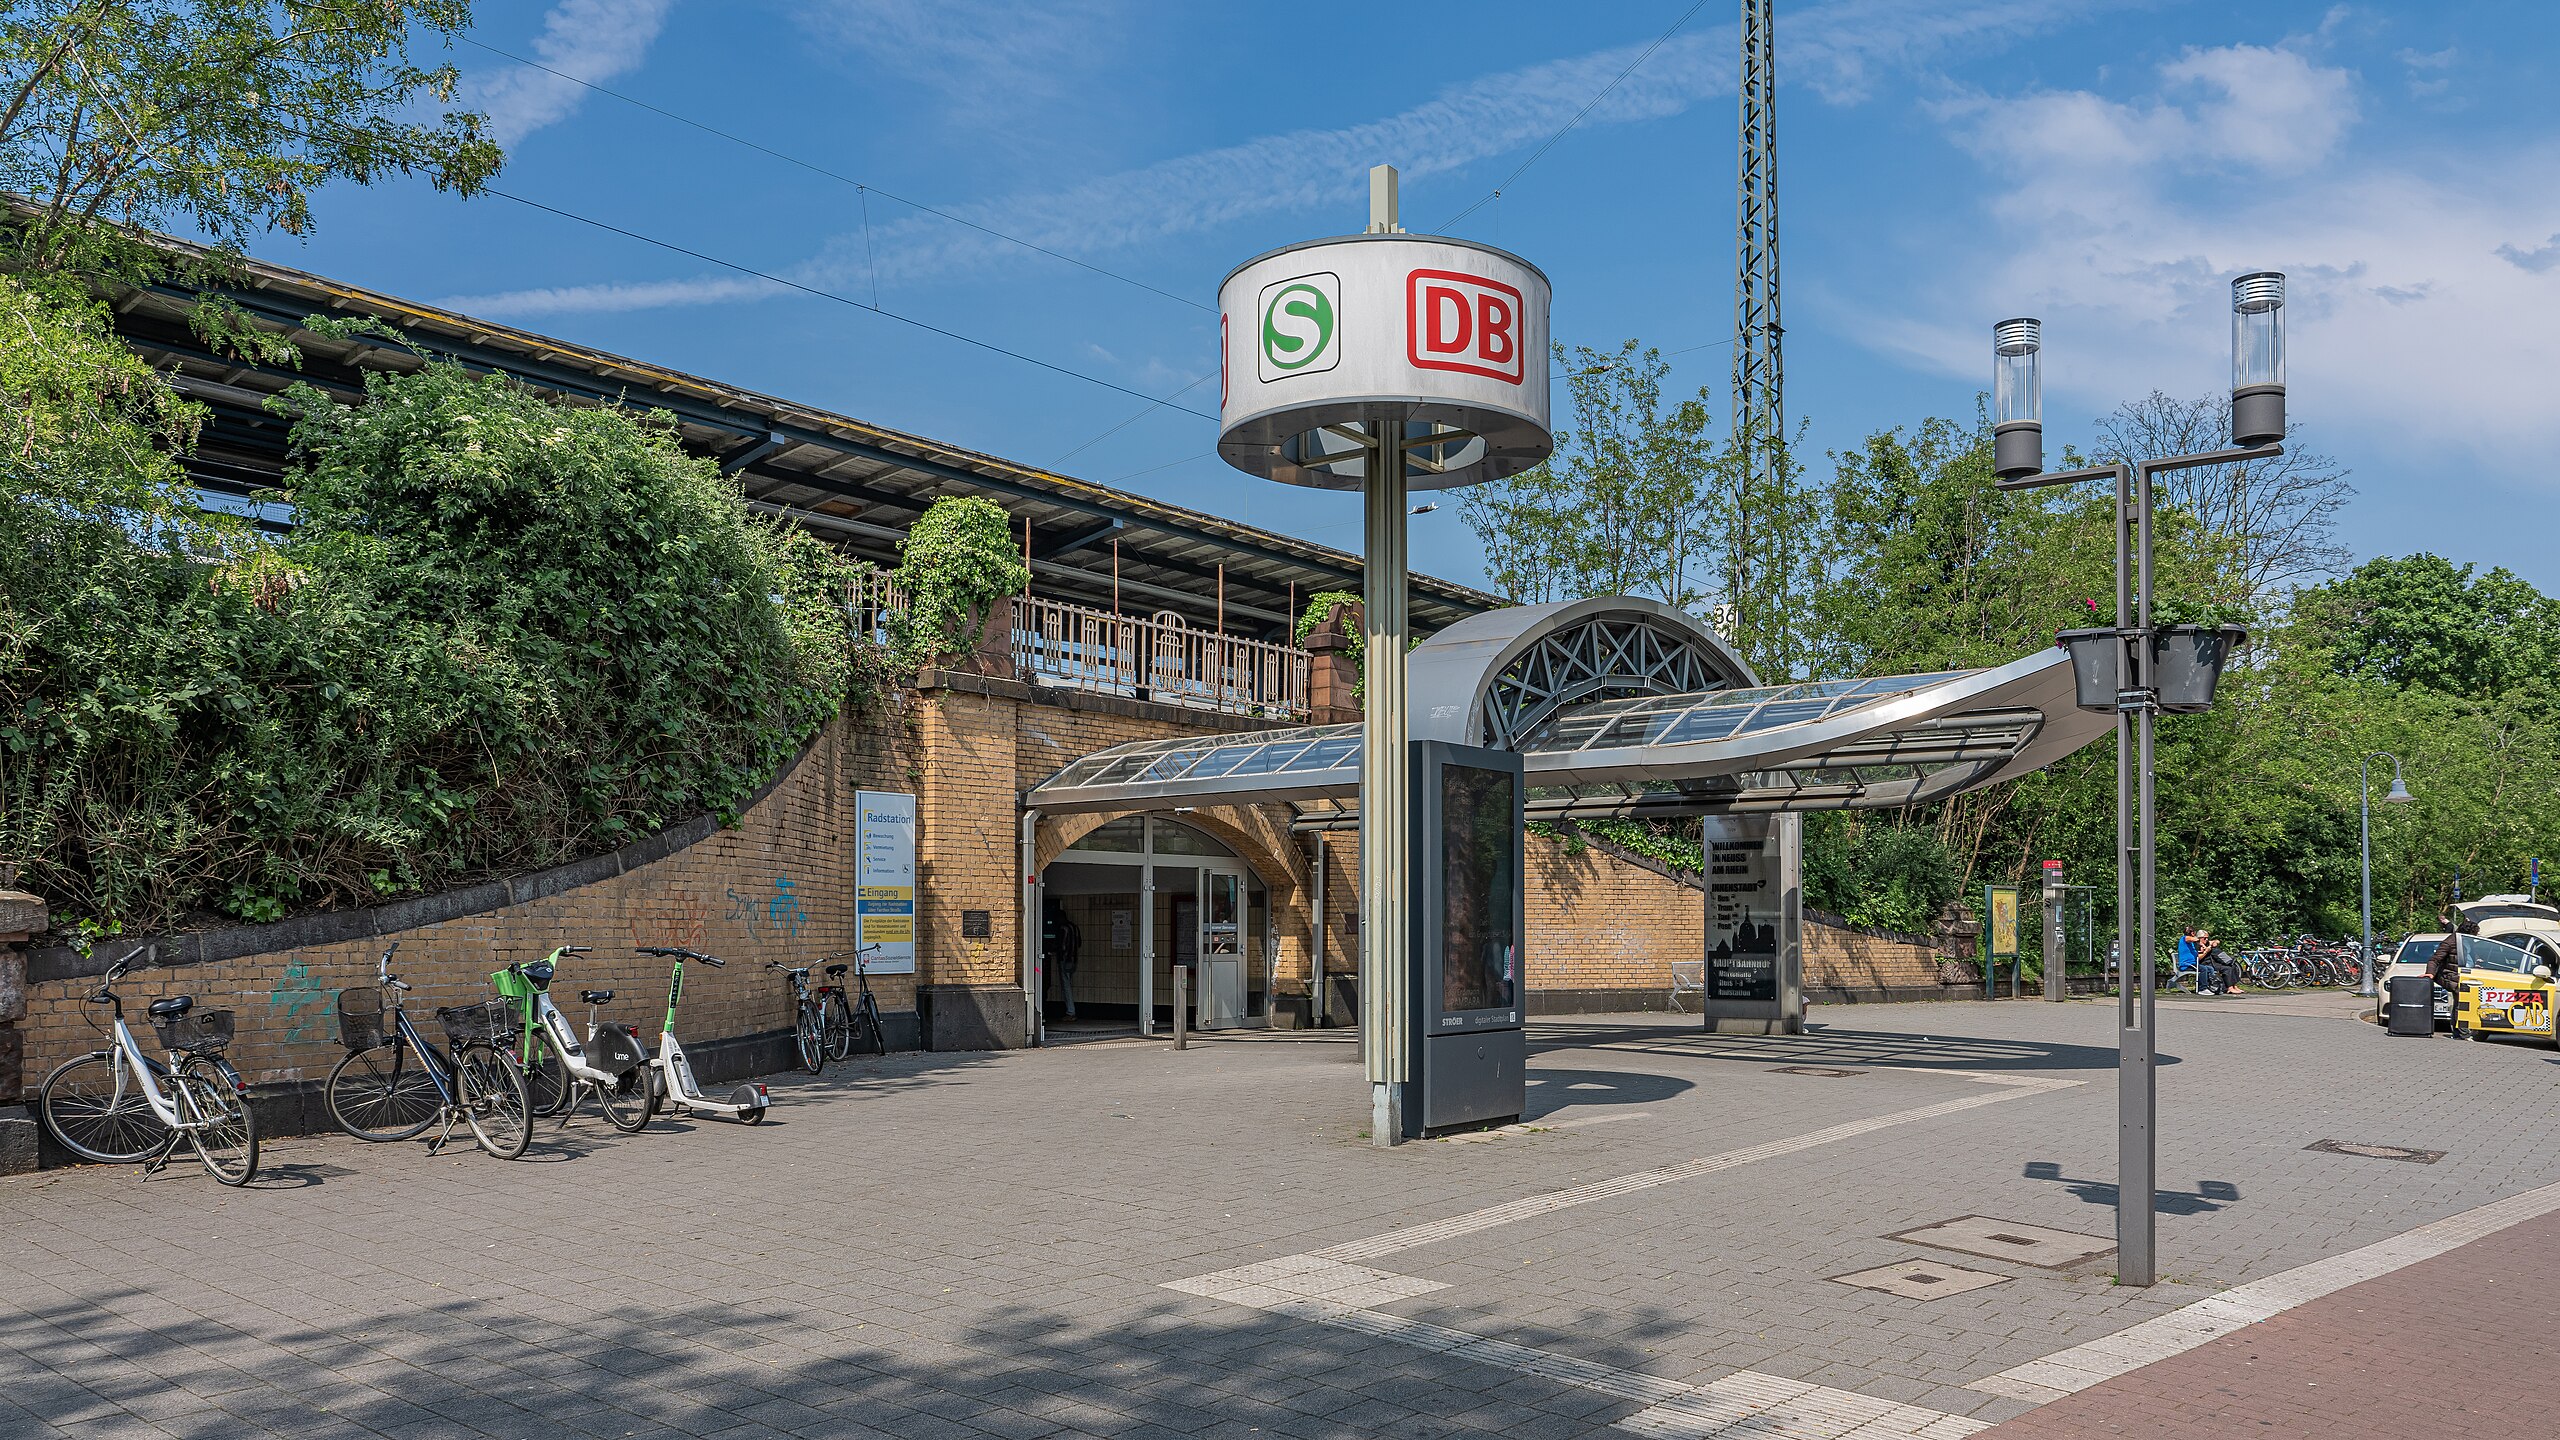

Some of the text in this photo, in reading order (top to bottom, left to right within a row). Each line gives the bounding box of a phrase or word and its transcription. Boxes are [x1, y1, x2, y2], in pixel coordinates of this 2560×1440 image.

[1271, 290, 1322, 364] S
[1425, 285, 1514, 364] DB
[867, 812, 911, 824] Radstation
[1712, 841, 1764, 851] WILLKOMMEN
[1712, 853, 1746, 862] IN NEUSS
[1712, 865, 1748, 875] AM RHEIN
[867, 887, 898, 899] Eingang
[1711, 883, 1758, 892] INNENSTADT
[1713, 958, 1771, 968] HAUPTBAHNHOF
[2486, 991, 2544, 1003] PIZZA
[2507, 1001, 2544, 1026] CAB
[1442, 1016, 1463, 1026] STRÖER
[1475, 1014, 1509, 1025] digitaler Stadtplan
